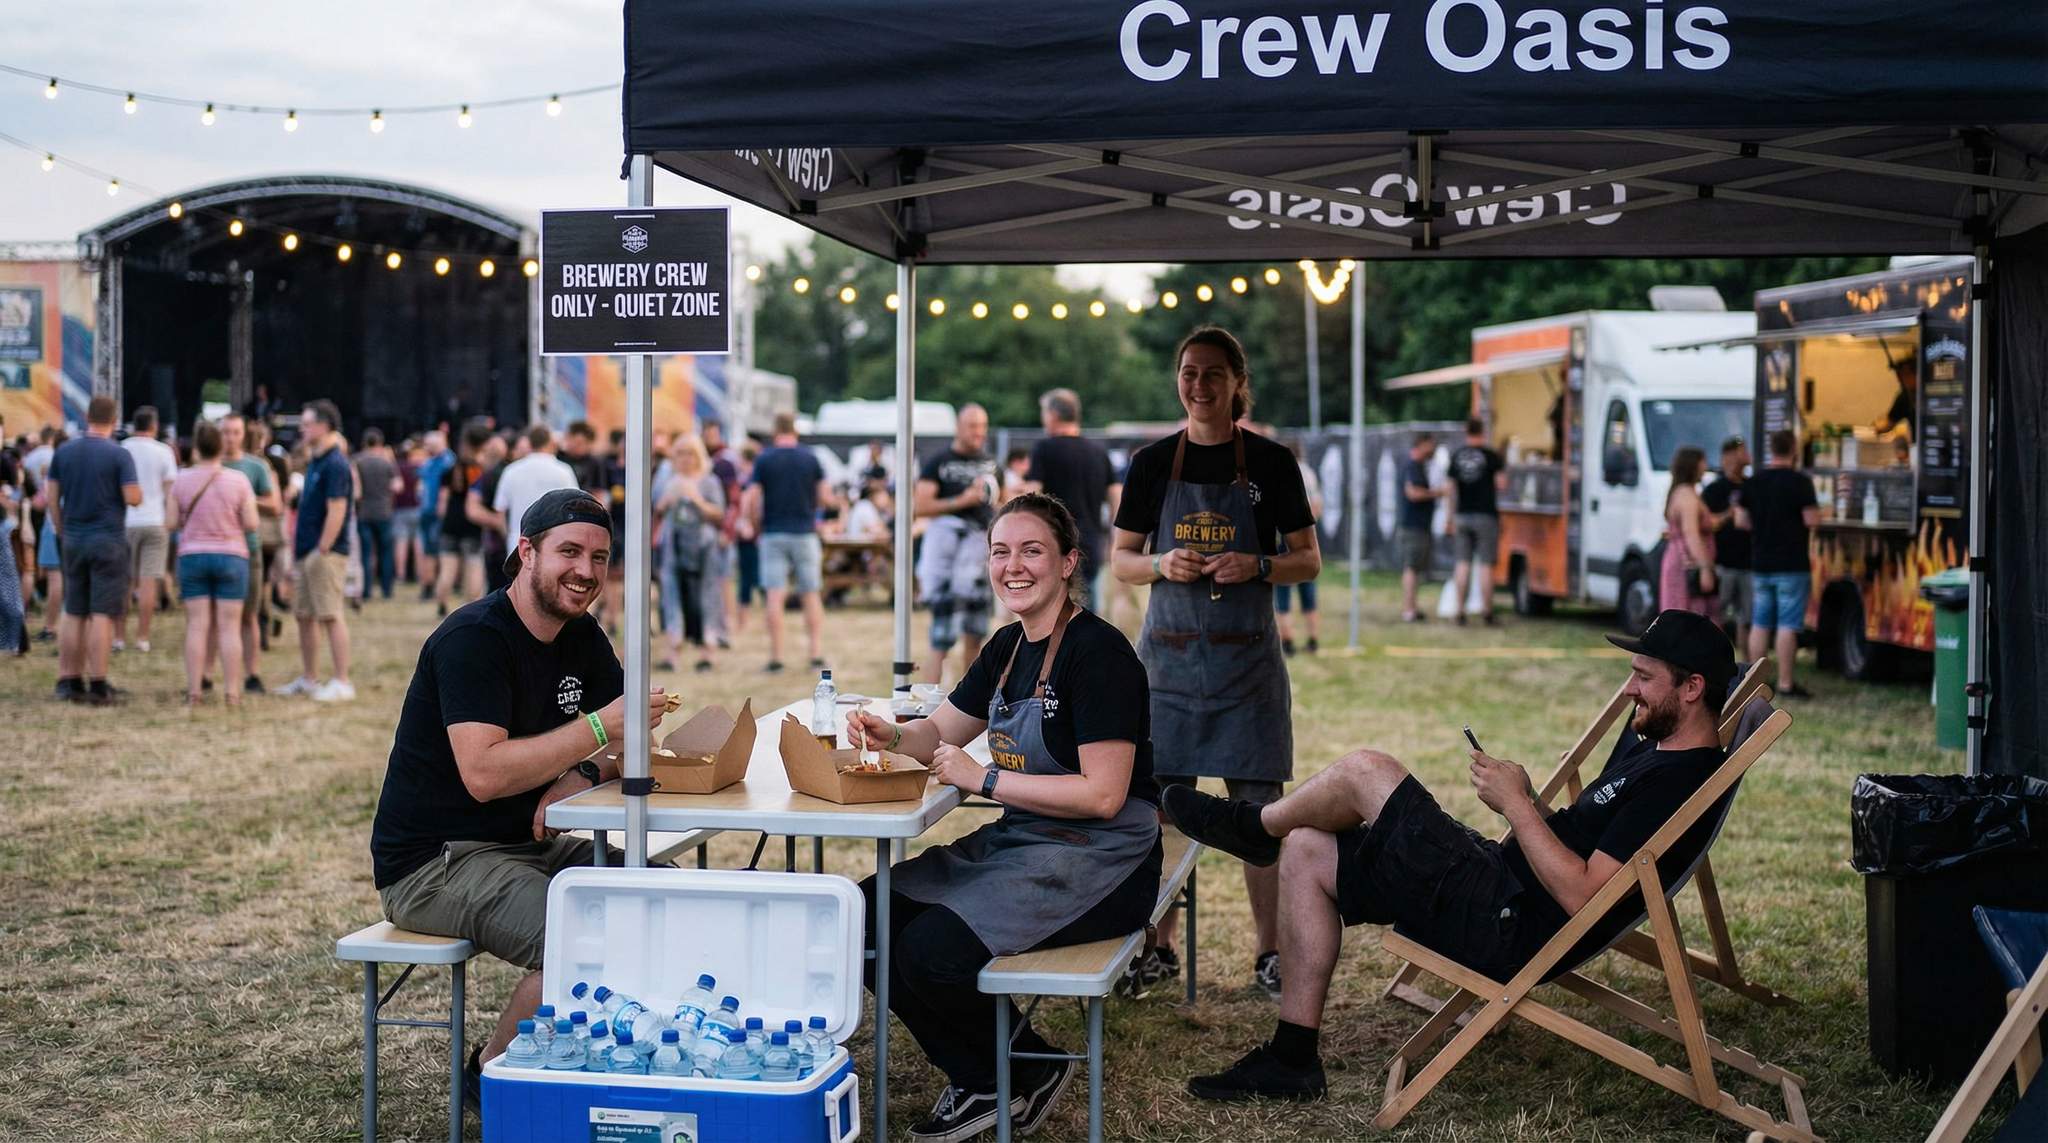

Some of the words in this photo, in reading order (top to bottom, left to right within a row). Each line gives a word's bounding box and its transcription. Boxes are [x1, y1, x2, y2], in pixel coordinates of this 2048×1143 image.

[1120, 0, 1391, 82] Crew
[1425, 0, 1730, 72] Oasis
[562, 263, 650, 288] BREWERY
[655, 262, 708, 287] CREW
[551, 294, 597, 318] ONLY
[614, 293, 667, 318] QUIET
[671, 292, 720, 316] ZONE
[1175, 523, 1236, 542] BREWERY
